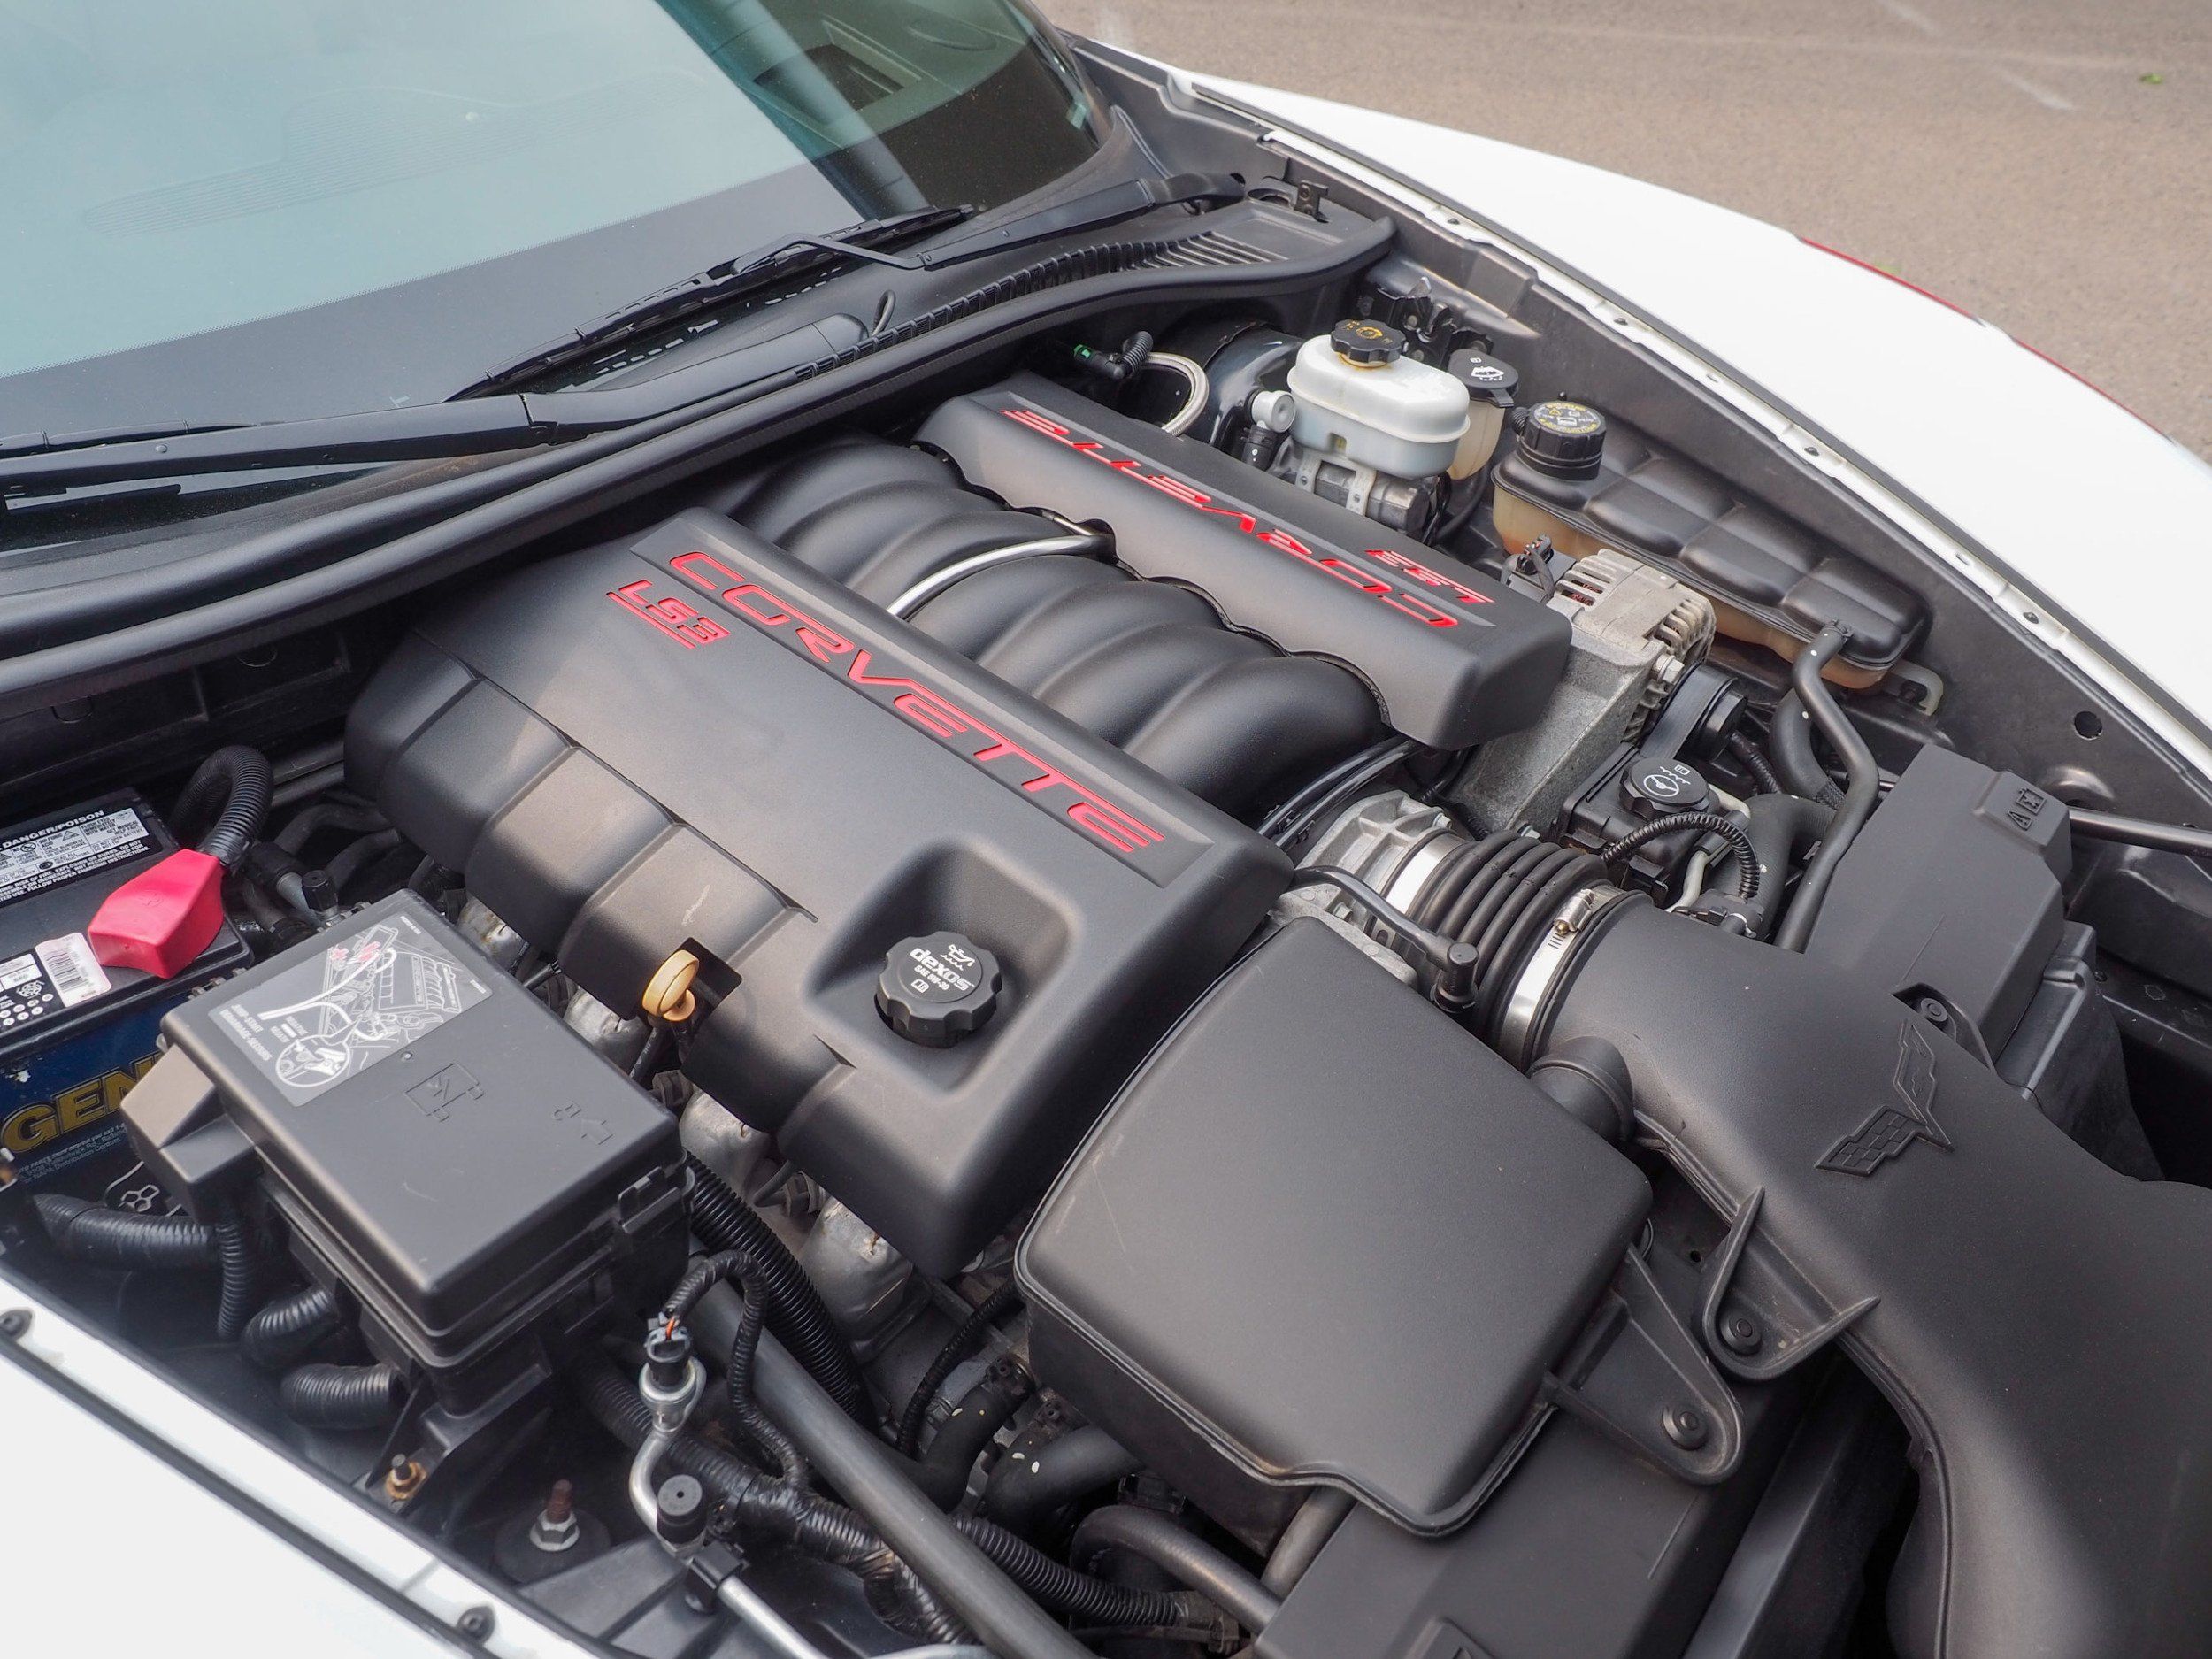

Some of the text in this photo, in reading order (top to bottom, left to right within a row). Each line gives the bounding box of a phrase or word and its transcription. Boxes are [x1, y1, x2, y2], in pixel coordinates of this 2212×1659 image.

[1000, 409, 1458, 627] CORVETTE
[1365, 549, 1490, 603] LS3
[619, 580, 731, 645] LS3
[669, 550, 1166, 853] CORVETTE
[2, 810, 105, 849] DANGER/POISON
[910, 948, 971, 991] dexos
[914, 964, 950, 990] SAE 5W-30
[2, 1050, 165, 1154] GEN
